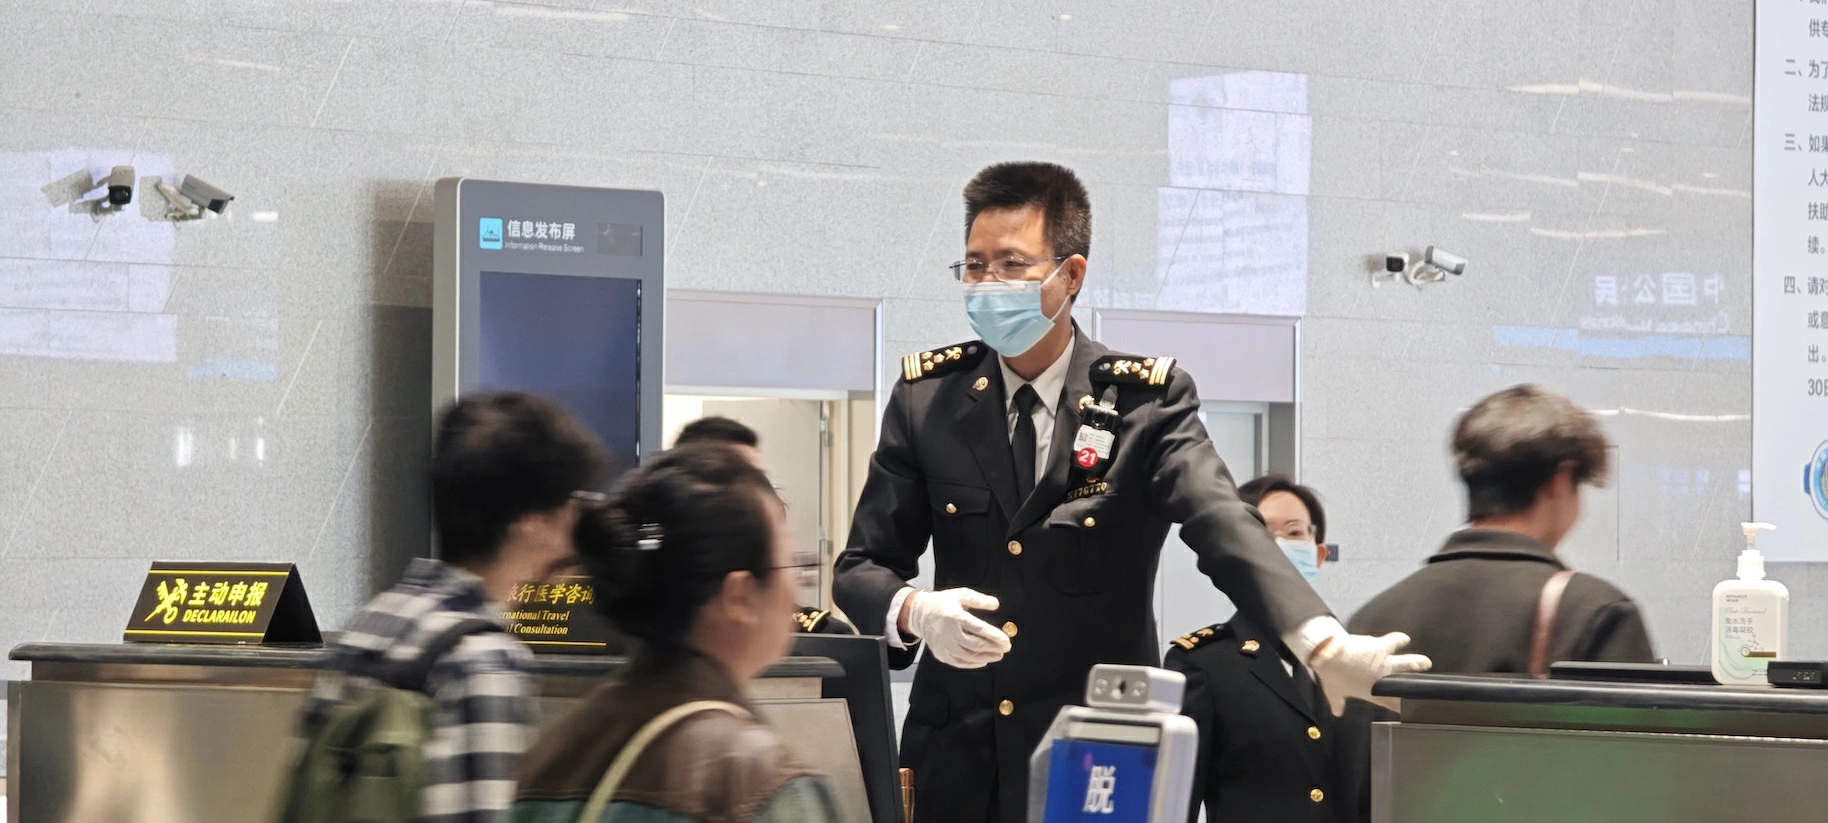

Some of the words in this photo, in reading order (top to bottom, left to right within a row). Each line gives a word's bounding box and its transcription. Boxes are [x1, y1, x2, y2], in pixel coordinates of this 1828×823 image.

[507, 219, 576, 240] 信息发布屏
[505, 241, 537, 250] Information
[538, 241, 563, 252] Release
[563, 243, 585, 253] Screen
[1807, 343, 1826, 363] 出。
[1079, 449, 1097, 465] 21
[188, 581, 268, 606] 主动申报
[182, 609, 257, 624] DECLARAILON
[541, 610, 571, 621] Travel
[514, 622, 569, 634] Consultation
